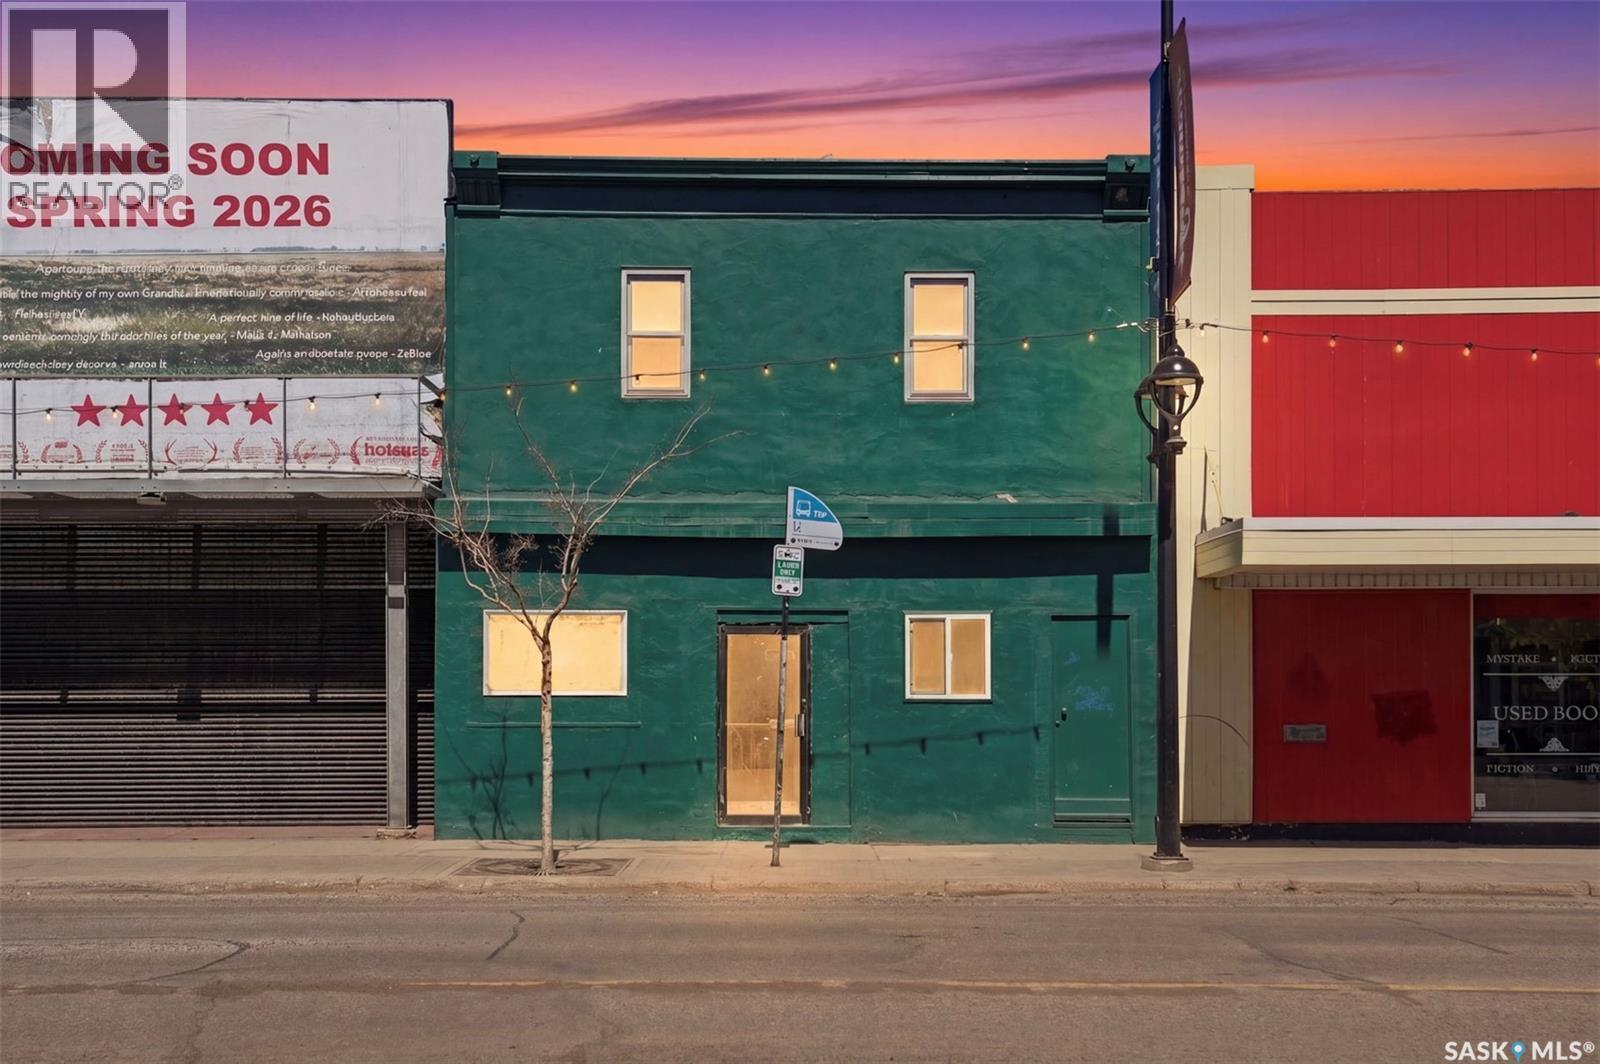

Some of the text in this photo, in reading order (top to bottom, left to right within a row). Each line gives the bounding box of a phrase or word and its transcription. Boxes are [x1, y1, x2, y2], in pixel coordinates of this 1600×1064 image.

[0, 143, 330, 175] OMING SOON
[7, 195, 331, 228] SPRING 2026
[20, 289, 39, 298] the
[85, 288, 97, 298] of
[99, 290, 115, 300] my
[117, 290, 140, 298] own
[170, 331, 181, 340] of
[183, 331, 200, 340] the
[1493, 705, 1599, 720] USED BOO
